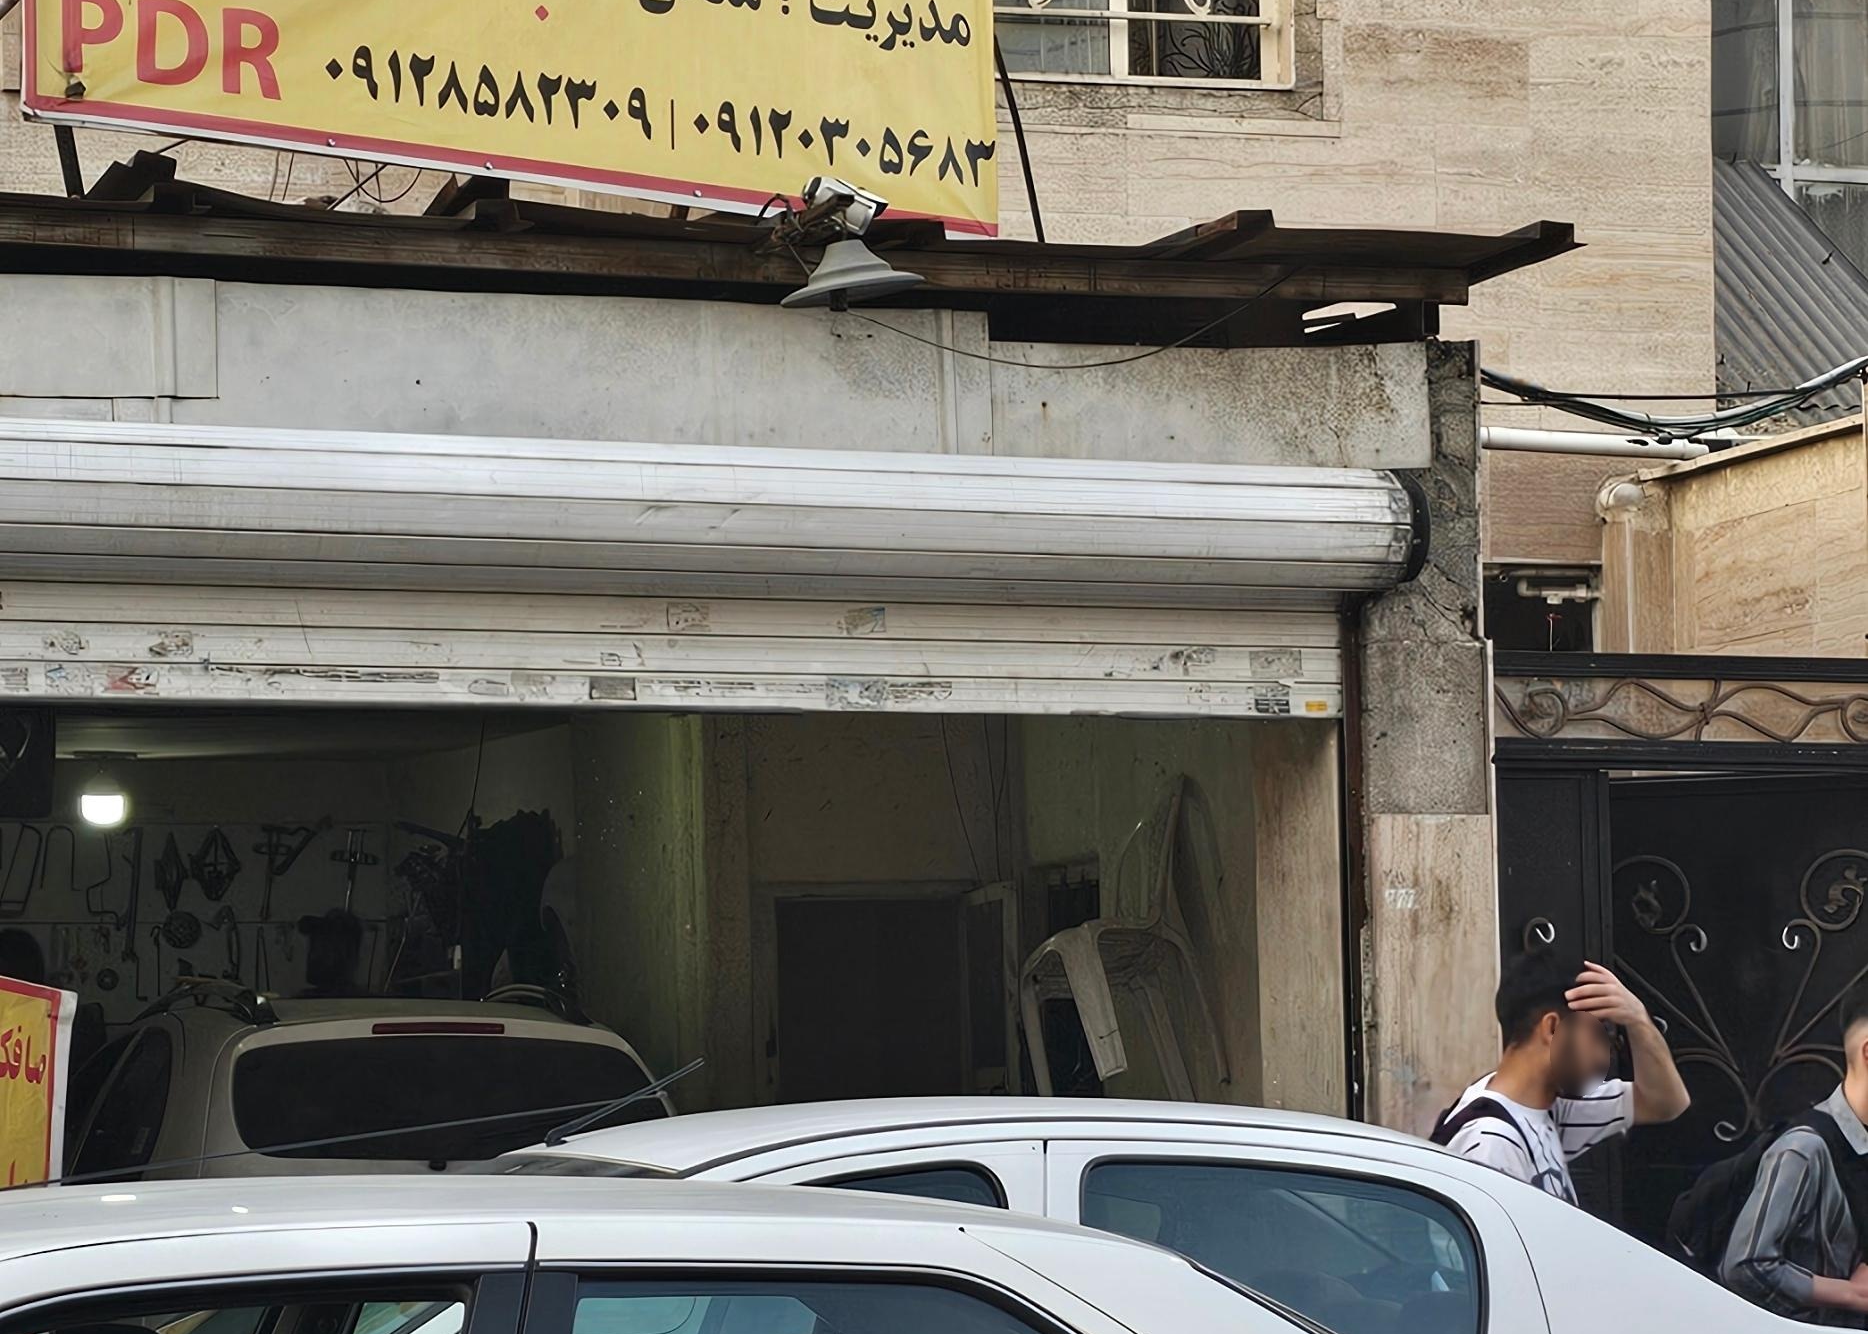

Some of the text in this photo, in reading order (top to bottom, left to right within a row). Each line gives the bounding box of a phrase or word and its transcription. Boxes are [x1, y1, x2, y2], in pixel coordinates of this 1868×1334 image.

[325, 45, 652, 140] ۰۹۱۲۸۵۸۲۳۰۹
[693, 101, 995, 187] ۰۹۱۲۰۳۰۵۶۸۳
[0, 1025, 47, 1084] صافک
